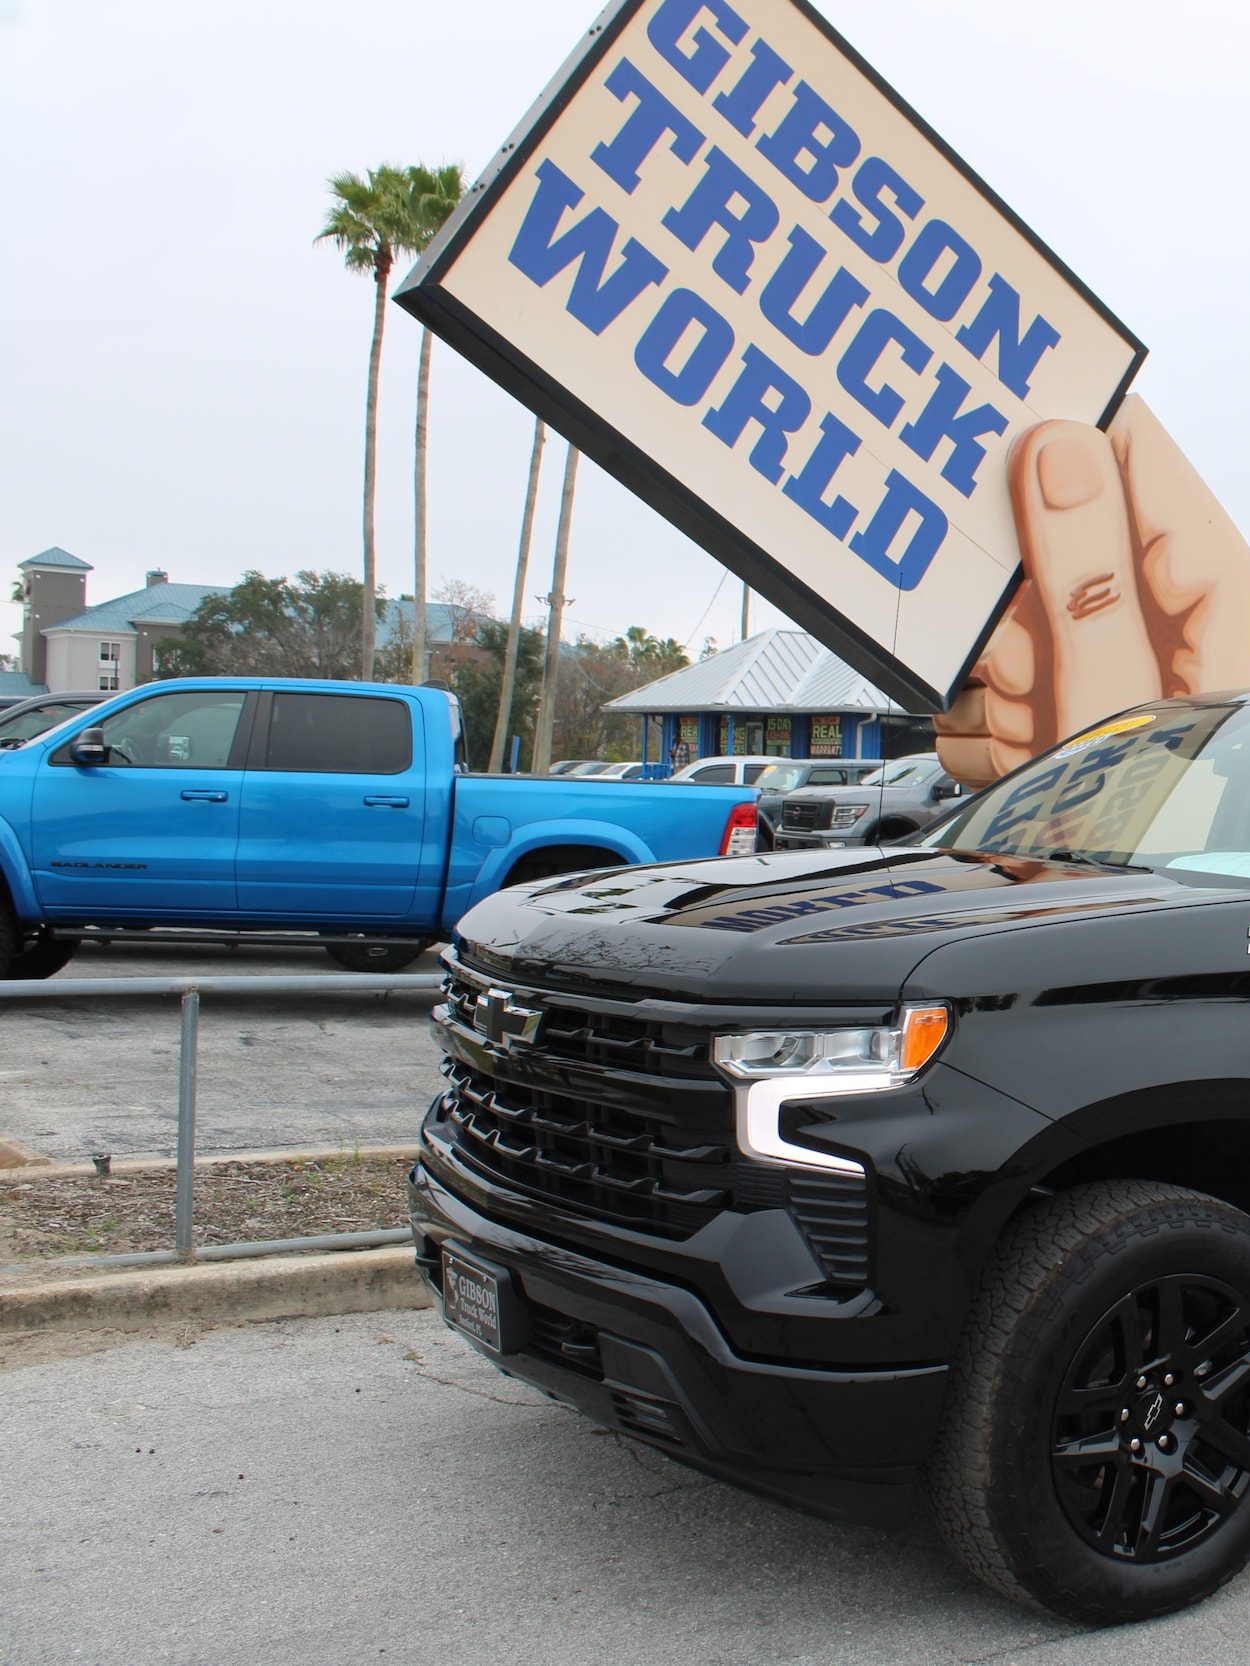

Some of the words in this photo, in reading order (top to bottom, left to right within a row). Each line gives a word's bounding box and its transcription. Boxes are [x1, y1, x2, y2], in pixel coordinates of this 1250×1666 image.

[647, 0, 1062, 401] GIBSON
[590, 57, 1010, 500] TRUCK
[507, 157, 949, 592] WORLD
[681, 725, 698, 737] REA
[720, 727, 745, 740] KNG
[812, 725, 842, 738] REAL
[459, 1275, 496, 1313] GIBSON
[460, 1297, 478, 1319] Truck
[478, 1307, 497, 1329] World
